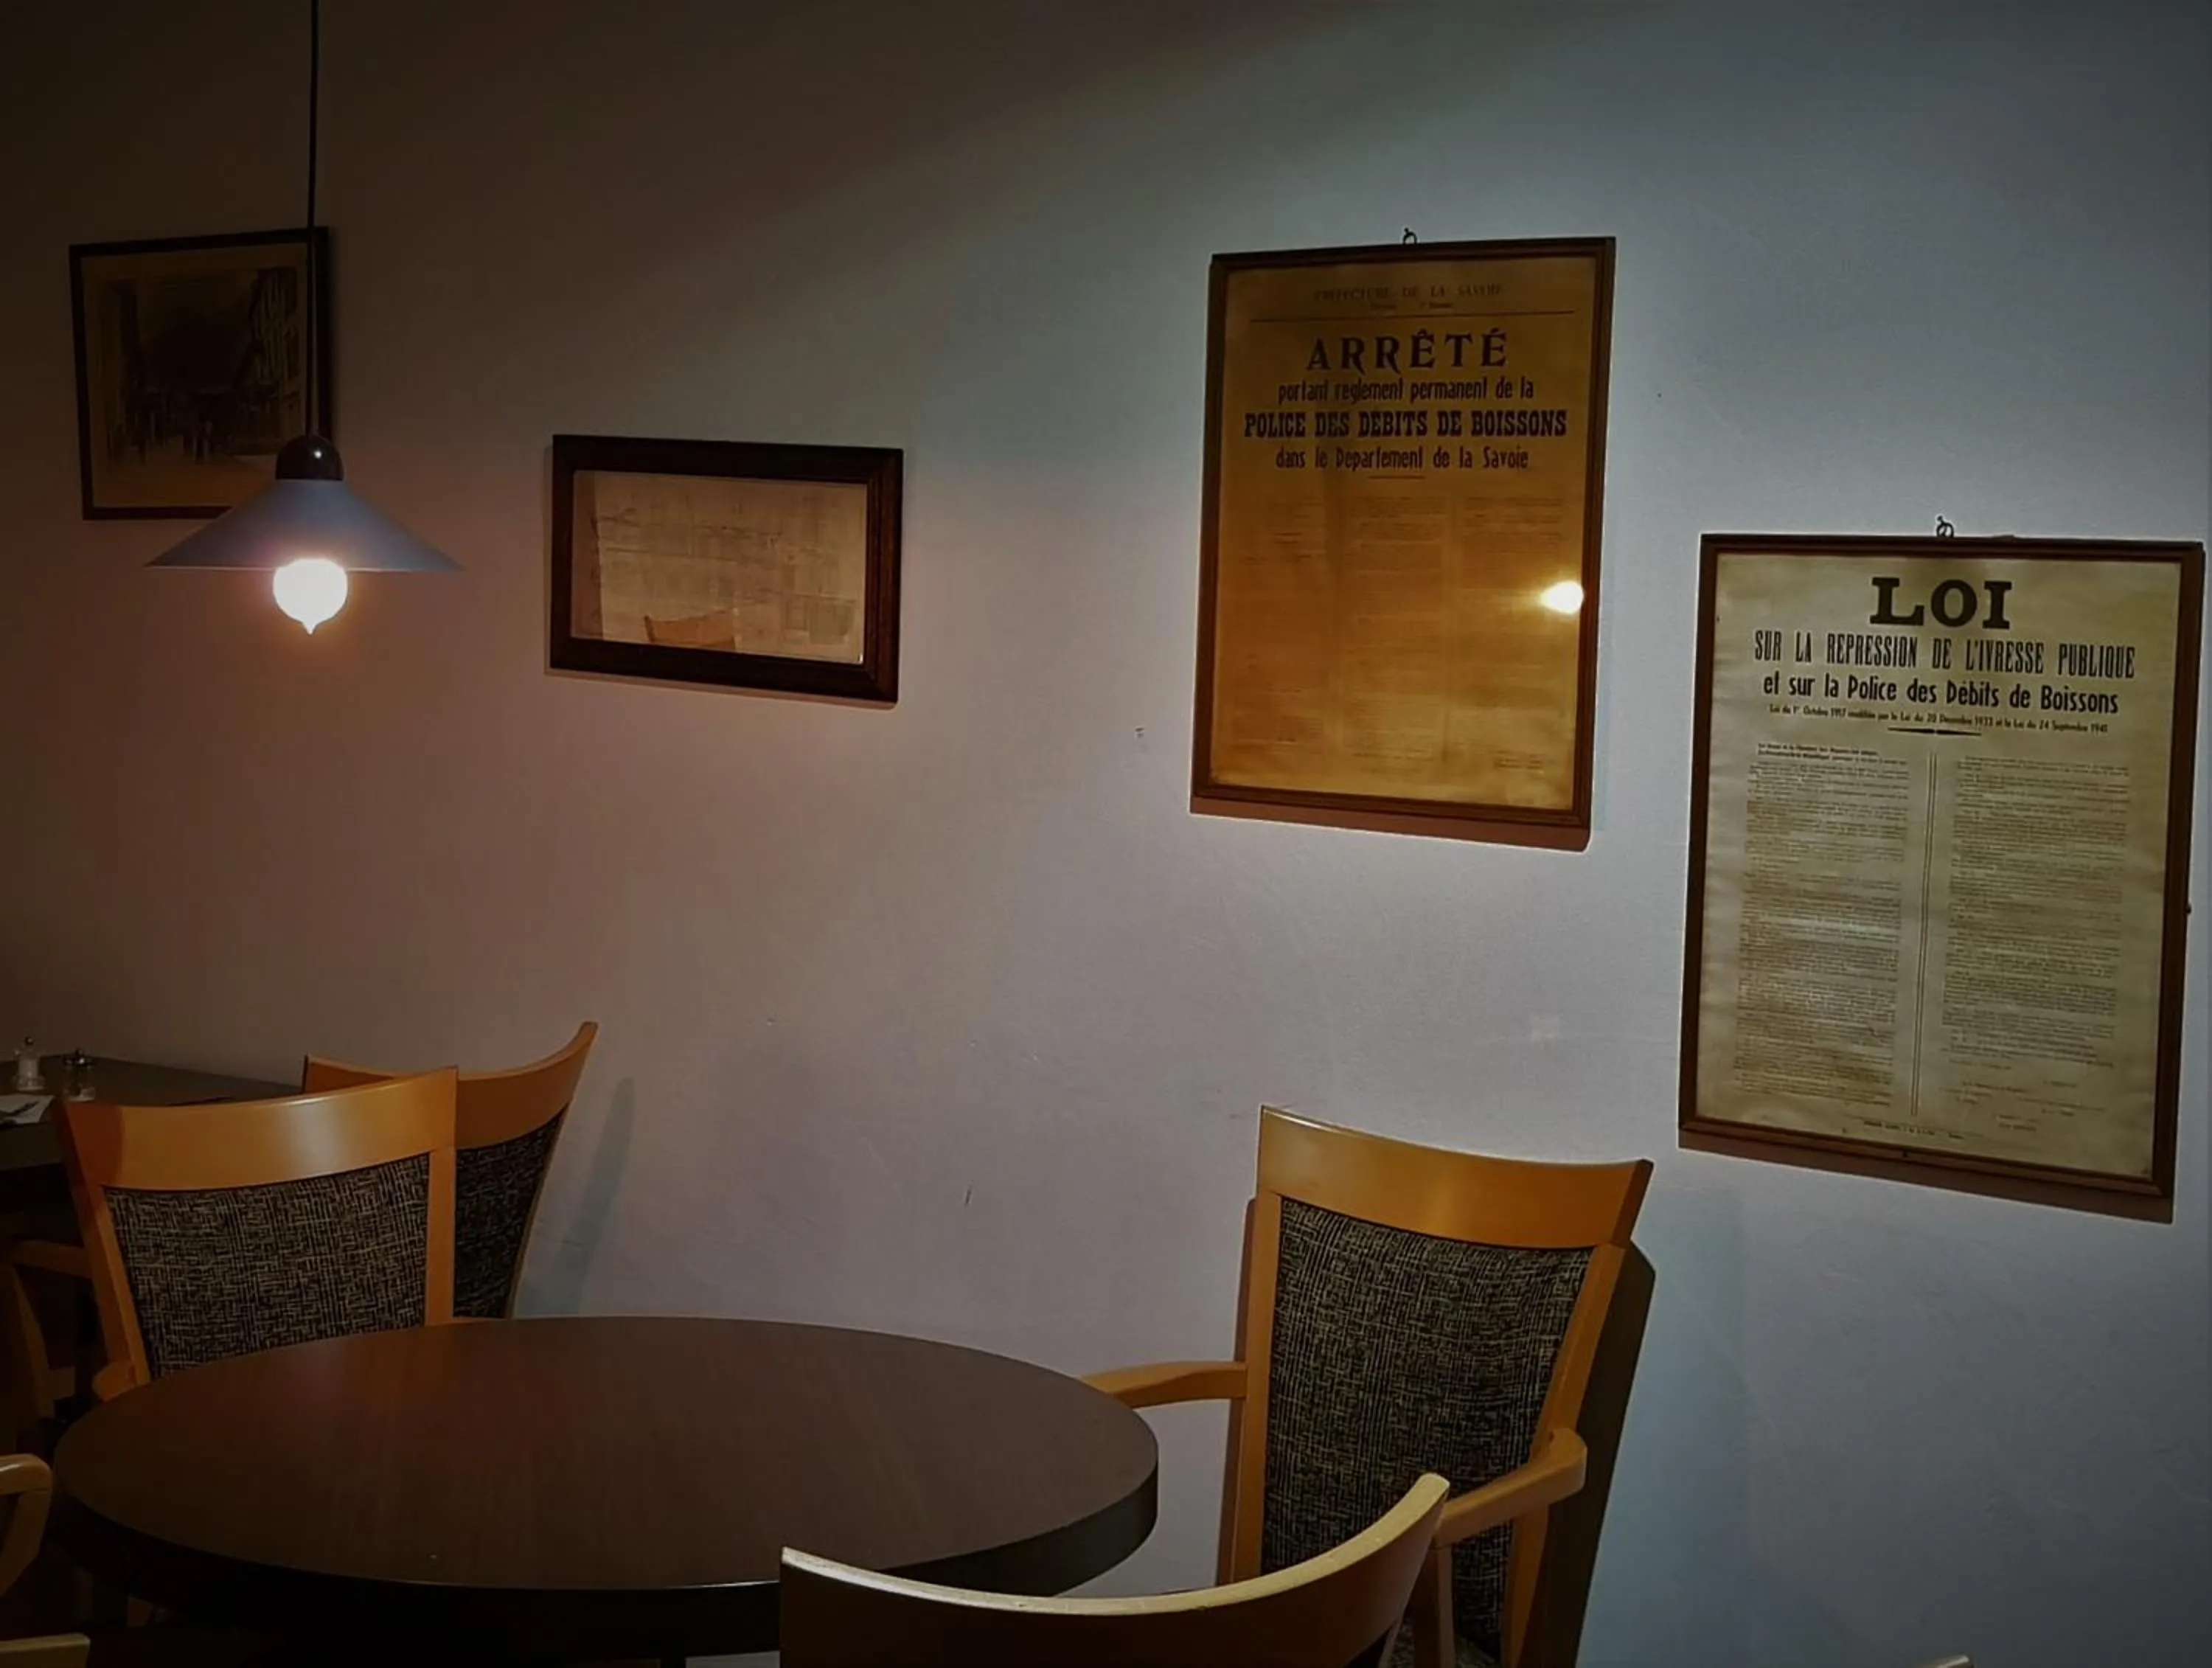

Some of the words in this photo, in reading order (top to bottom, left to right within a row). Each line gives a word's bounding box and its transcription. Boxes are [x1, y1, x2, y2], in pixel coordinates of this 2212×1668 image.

[1307, 327, 1507, 374] ARRÊTÉ
[1279, 378, 1328, 405] portant
[1410, 377, 1487, 403] permanent
[1495, 375, 1512, 399] de
[1520, 376, 1534, 399] la
[1245, 412, 1306, 437] POLICE
[1315, 412, 1350, 437] DES
[1358, 411, 1427, 437] DEBITS
[1437, 410, 1462, 437] DE
[1471, 409, 1567, 437] BOISSONS
[1276, 446, 1306, 468] dans
[1315, 447, 1328, 468] le
[1433, 445, 1450, 468] de
[1459, 445, 1472, 468] la
[1483, 444, 1528, 468] Savoie
[1869, 577, 2013, 629] LOI
[1755, 630, 1781, 661] SUR
[1795, 631, 1812, 663] LA
[1826, 633, 1918, 667] REPRESSION
[1932, 638, 1952, 670] DE
[1966, 639, 2045, 674] L'IVRESSE
[2058, 643, 2135, 678] PUBLIQUE
[1763, 670, 1779, 695] et
[1788, 676, 1816, 697] sur
[1824, 673, 1839, 698] la
[1848, 674, 1897, 701] Police
[1906, 677, 1937, 703] des
[2008, 683, 2031, 709] de
[2040, 685, 2118, 713] Boissons
